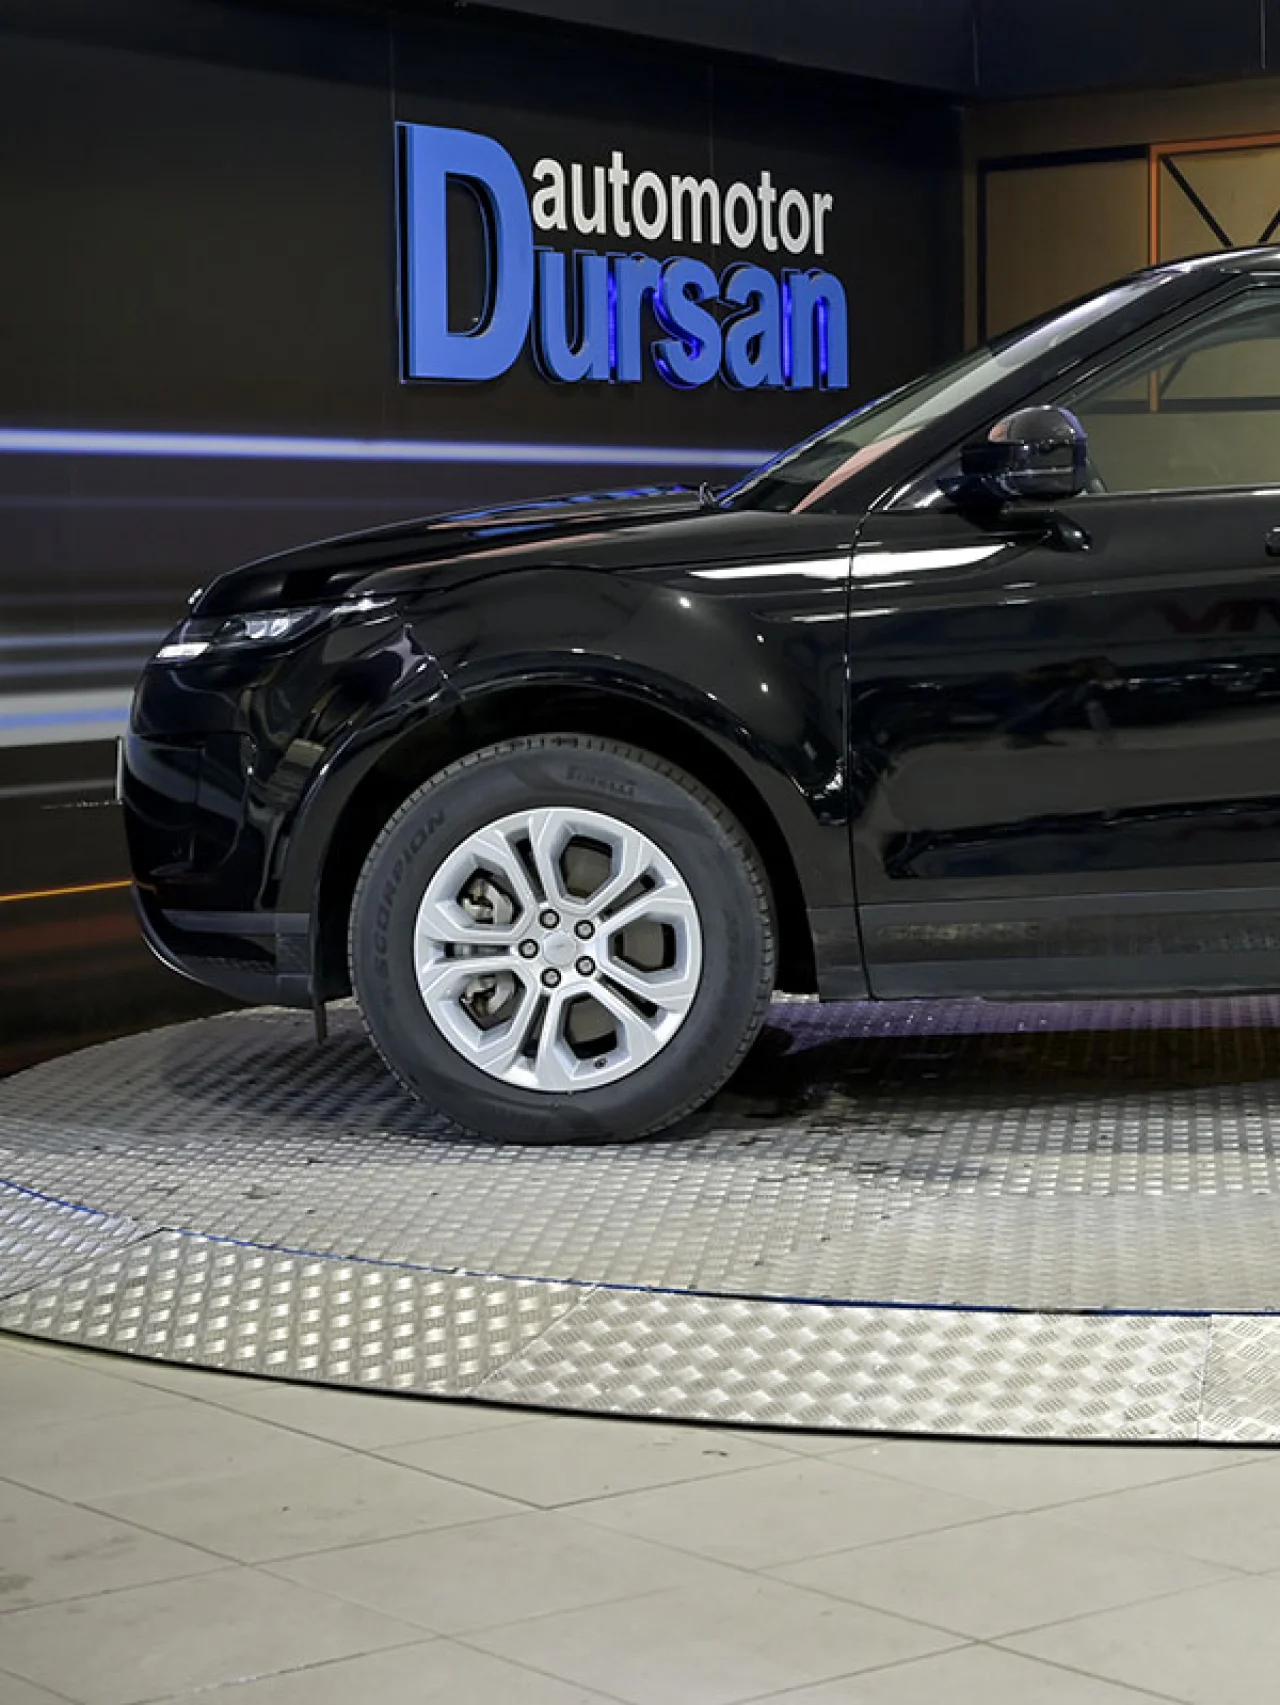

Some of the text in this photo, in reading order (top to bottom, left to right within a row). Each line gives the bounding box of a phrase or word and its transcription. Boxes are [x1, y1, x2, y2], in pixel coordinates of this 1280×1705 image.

[396, 121, 849, 391] Dursan
[531, 151, 833, 256] automotor
[375, 809, 446, 979] SCORPION
